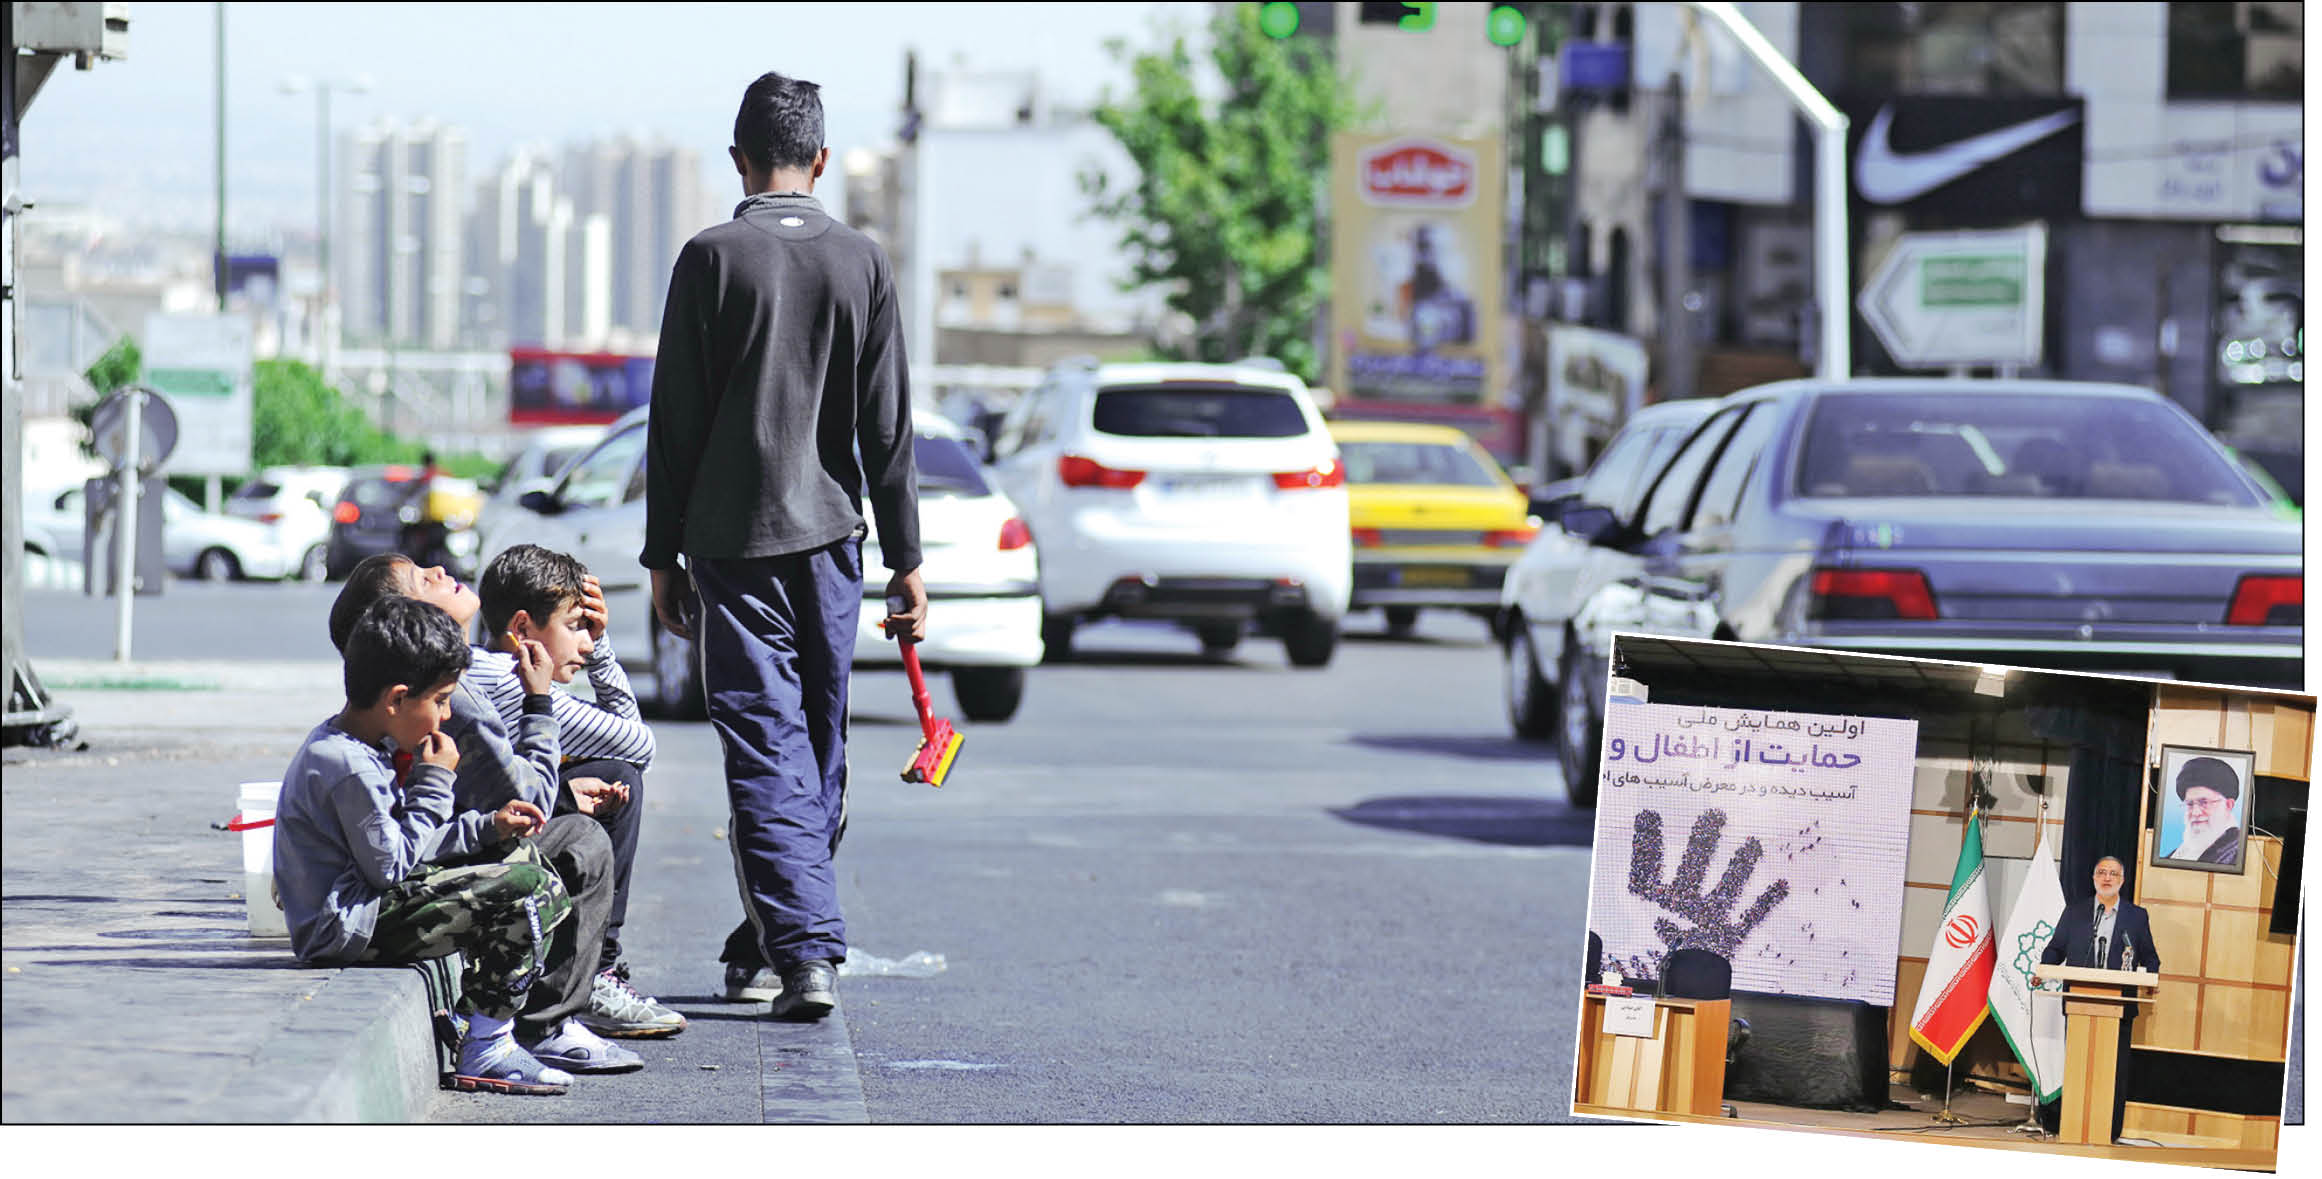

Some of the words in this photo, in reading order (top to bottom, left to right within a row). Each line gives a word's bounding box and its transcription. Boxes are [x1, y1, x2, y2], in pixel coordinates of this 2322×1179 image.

[1678, 709, 1718, 729] ملی
[1724, 712, 1800, 732] همایش
[1808, 719, 1864, 739] اولین
[1608, 738, 1626, 761] و
[1633, 733, 1719, 763] اطفال
[1724, 738, 1751, 769] از
[1760, 743, 1861, 773] حمایت
[1689, 778, 1737, 794] معرض
[1770, 785, 1807, 798] دیده
[1809, 785, 1858, 801] آسیب
